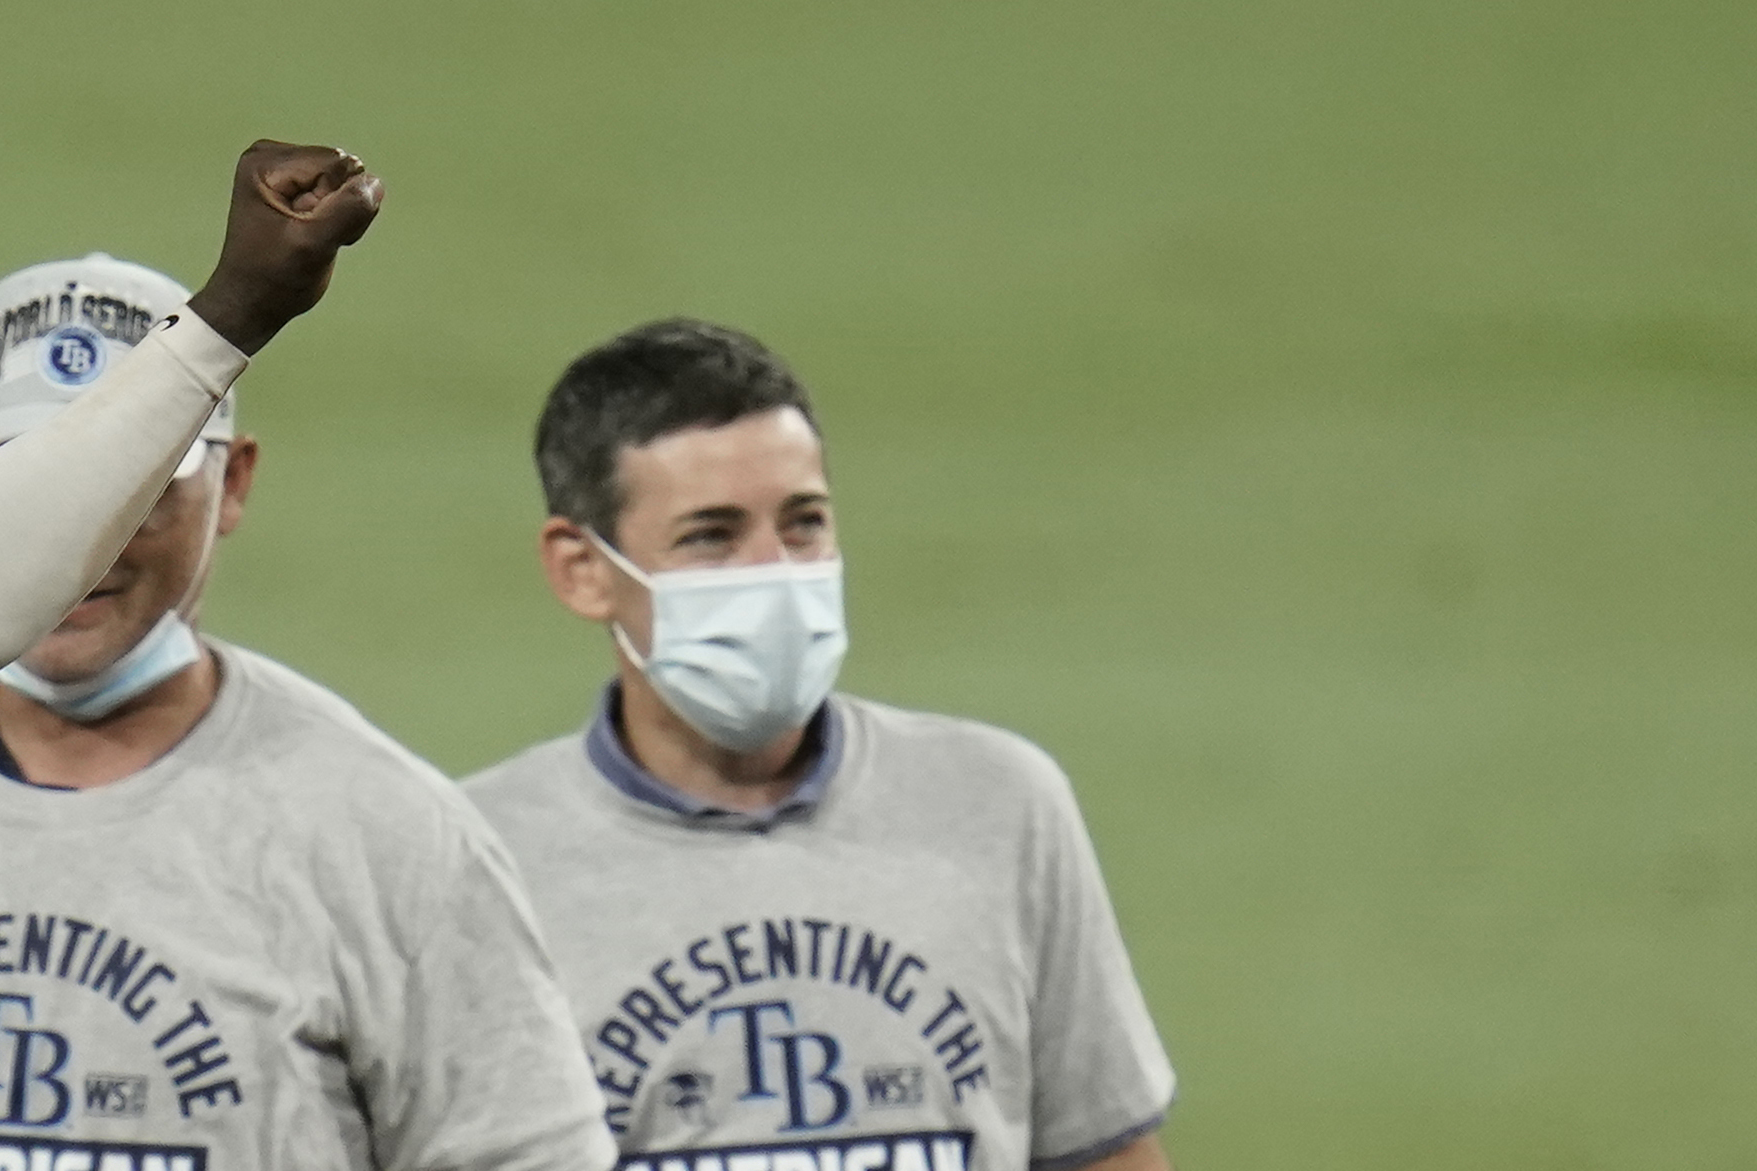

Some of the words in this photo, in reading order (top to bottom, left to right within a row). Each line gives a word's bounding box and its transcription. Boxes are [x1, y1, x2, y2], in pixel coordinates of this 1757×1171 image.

[153, 1001, 244, 1120] THE
[707, 998, 853, 1132] TB
[920, 987, 990, 1105] THE
